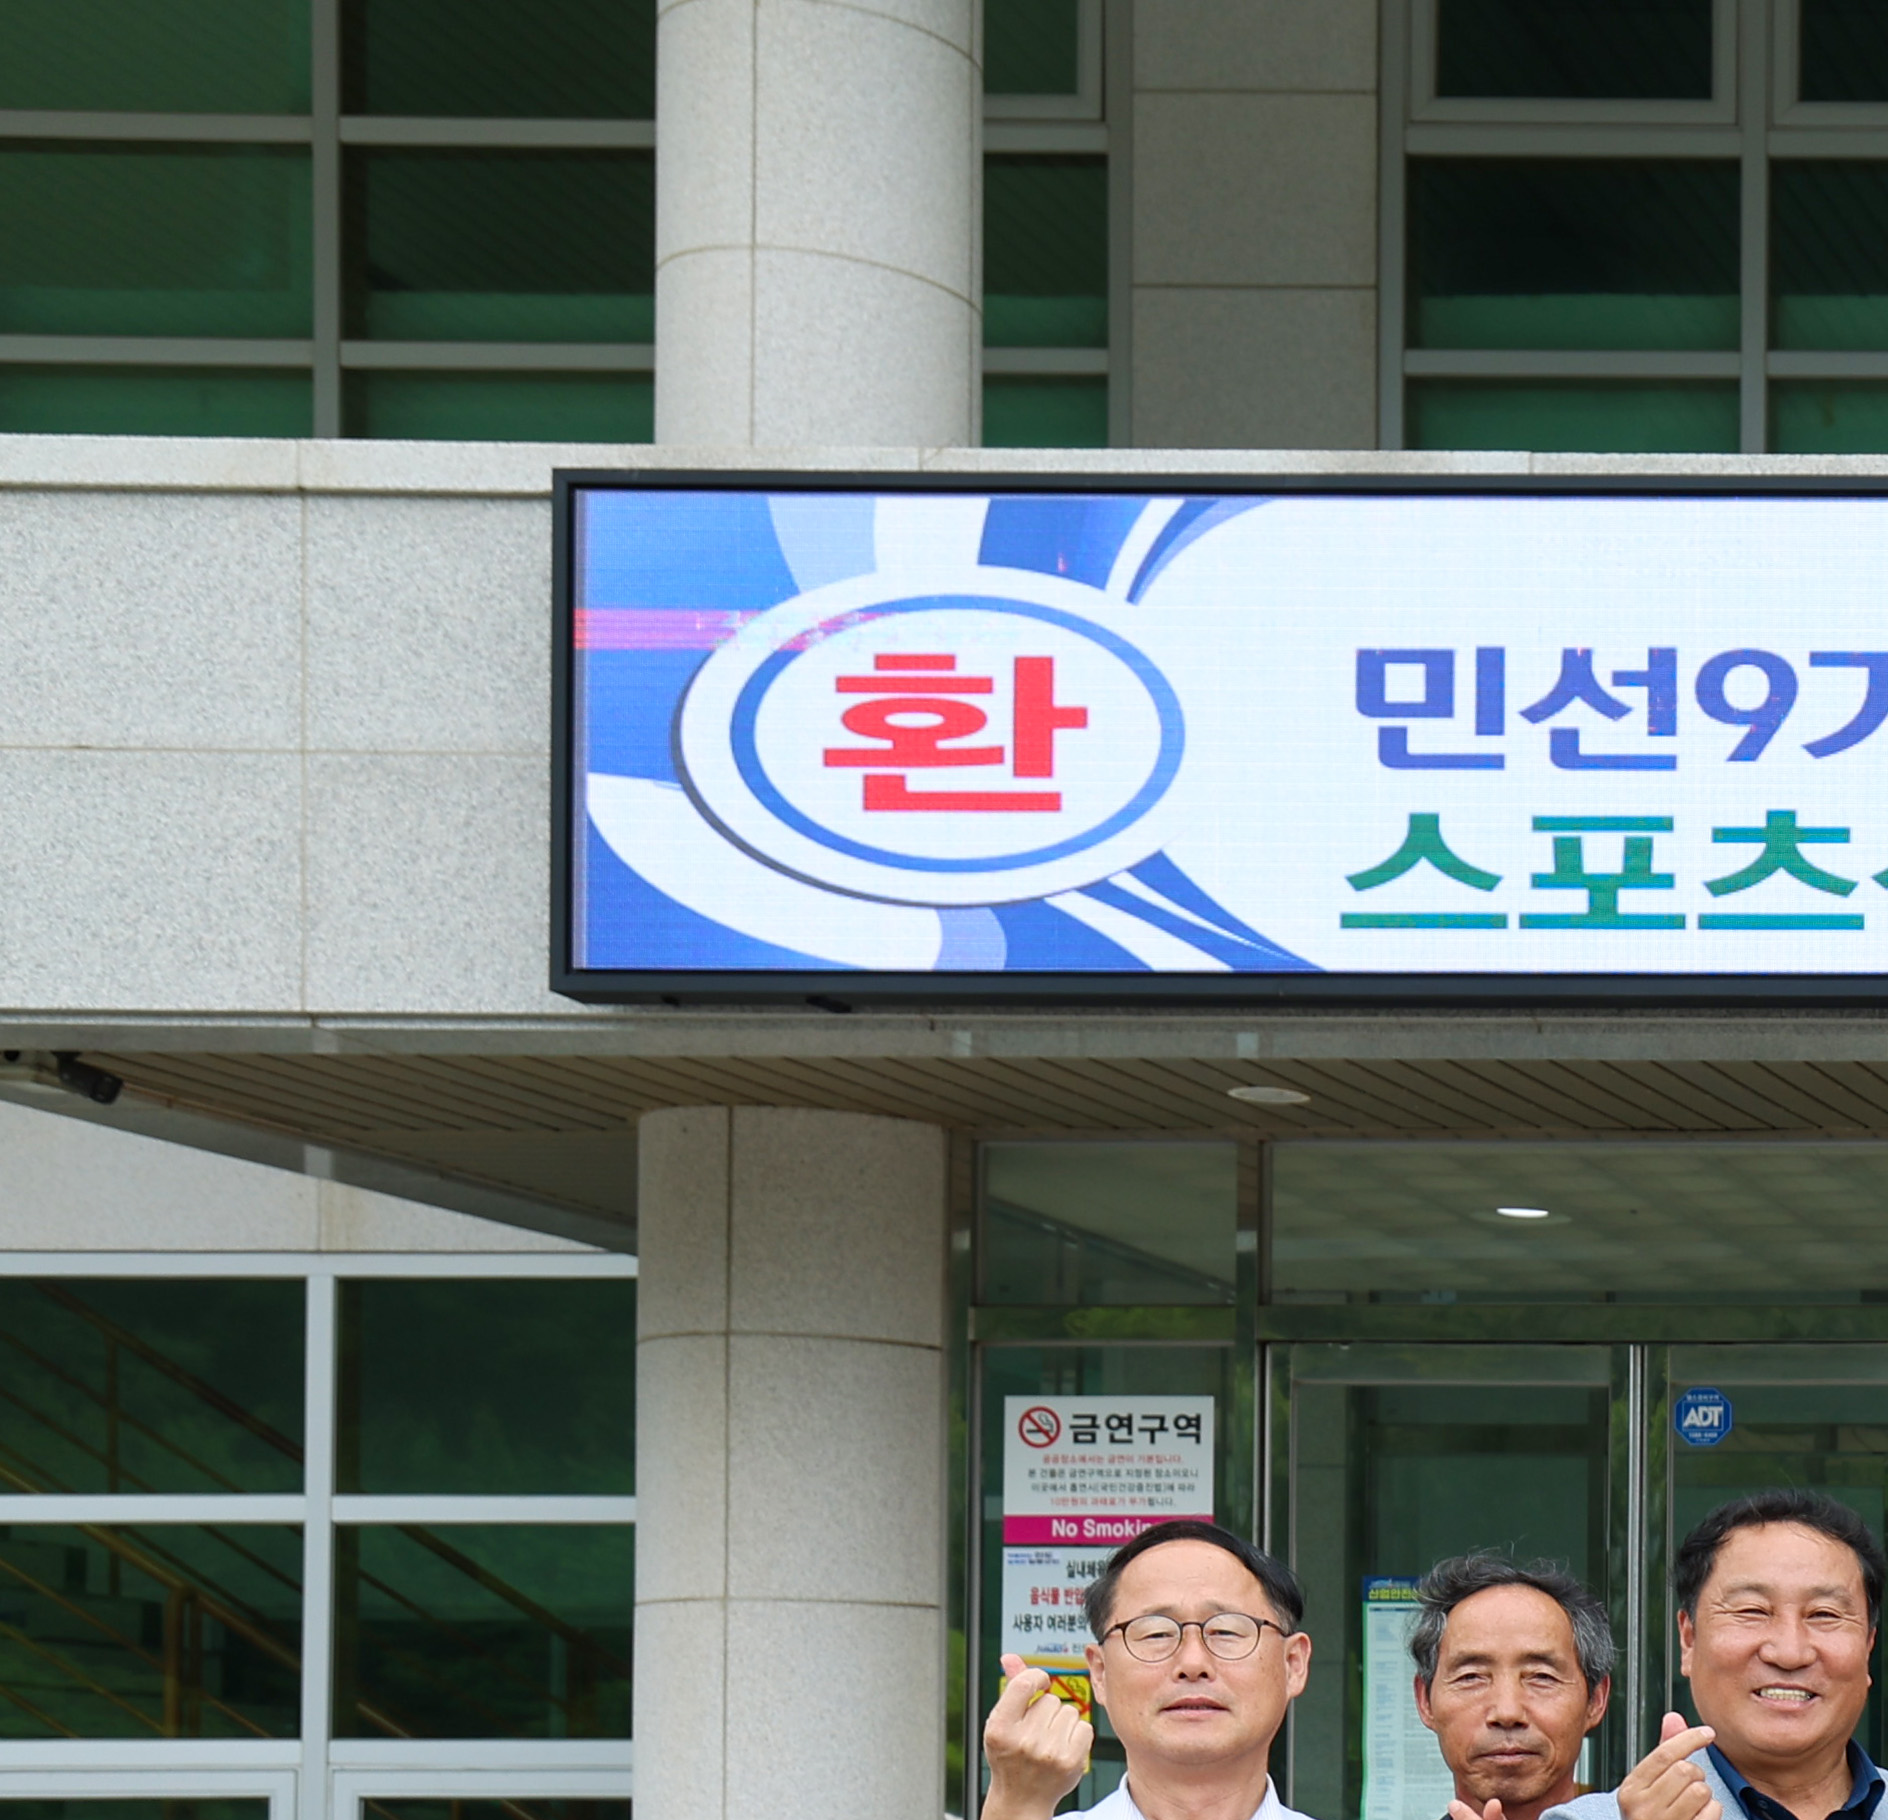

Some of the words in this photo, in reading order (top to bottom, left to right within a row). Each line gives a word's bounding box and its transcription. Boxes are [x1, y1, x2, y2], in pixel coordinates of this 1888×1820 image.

[822, 653, 1087, 813] 환
[1683, 1406, 1723, 1427] ADT
[1069, 1413, 1202, 1445] 금연구역
[1052, 1519, 1078, 1538] No
[1083, 1518, 1154, 1538] Smokin
[1013, 1614, 1043, 1633] 사용자
